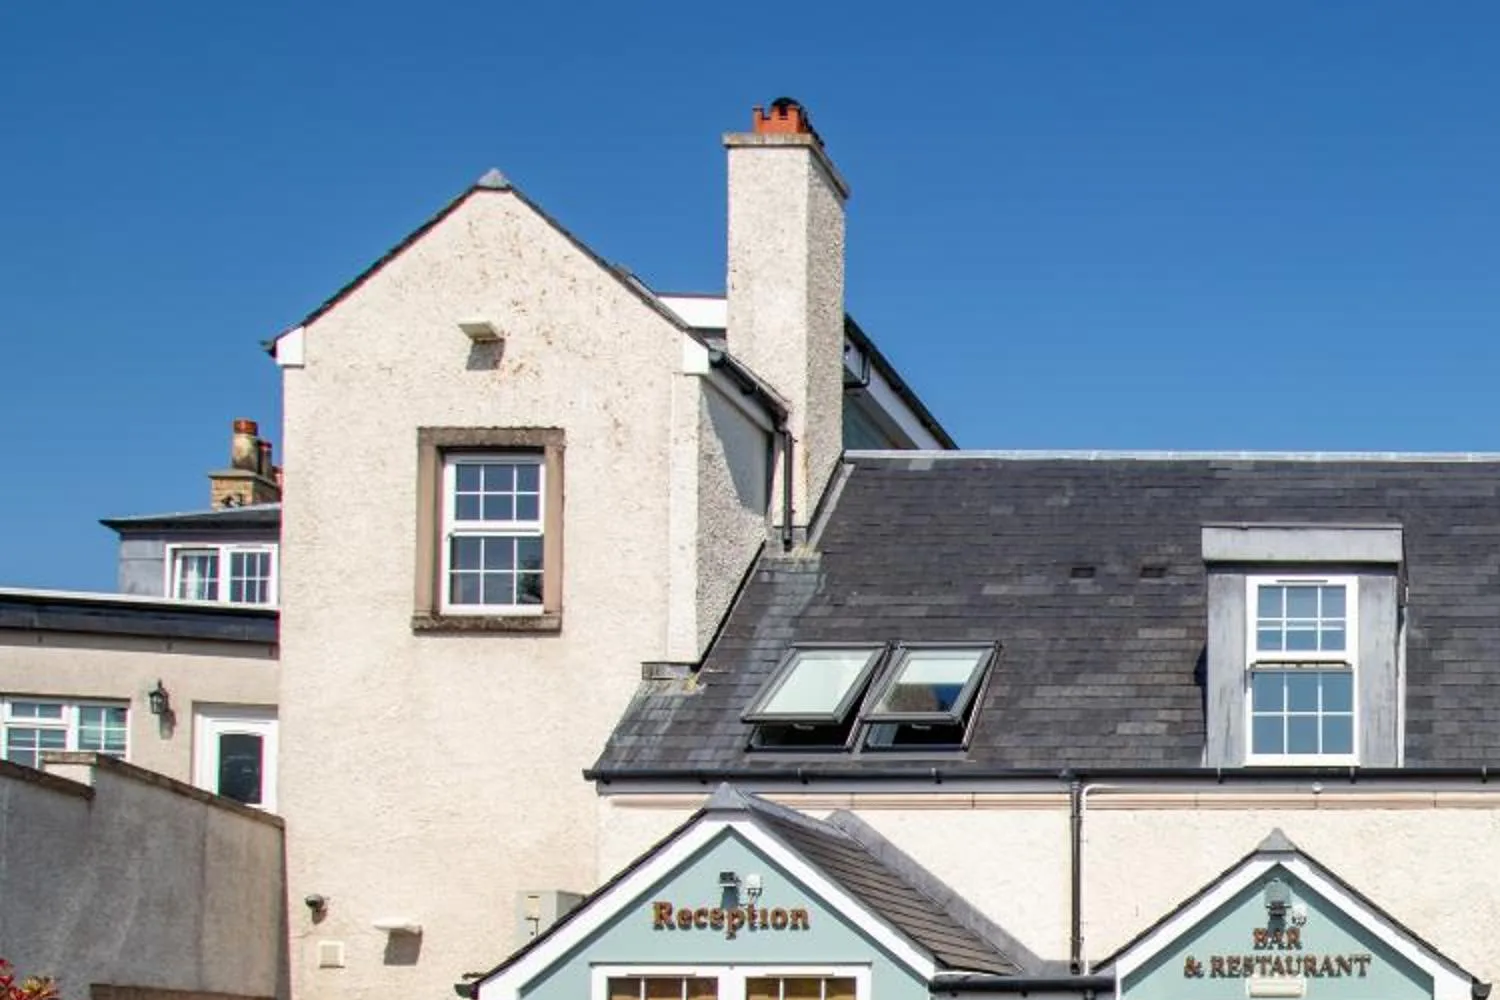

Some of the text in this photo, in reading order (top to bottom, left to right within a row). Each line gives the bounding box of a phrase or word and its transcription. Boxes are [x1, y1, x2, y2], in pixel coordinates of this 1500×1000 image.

[652, 900, 810, 940] Reception
[1253, 927, 1302, 950] BAR
[1183, 953, 1372, 979] & RESTAURANT
